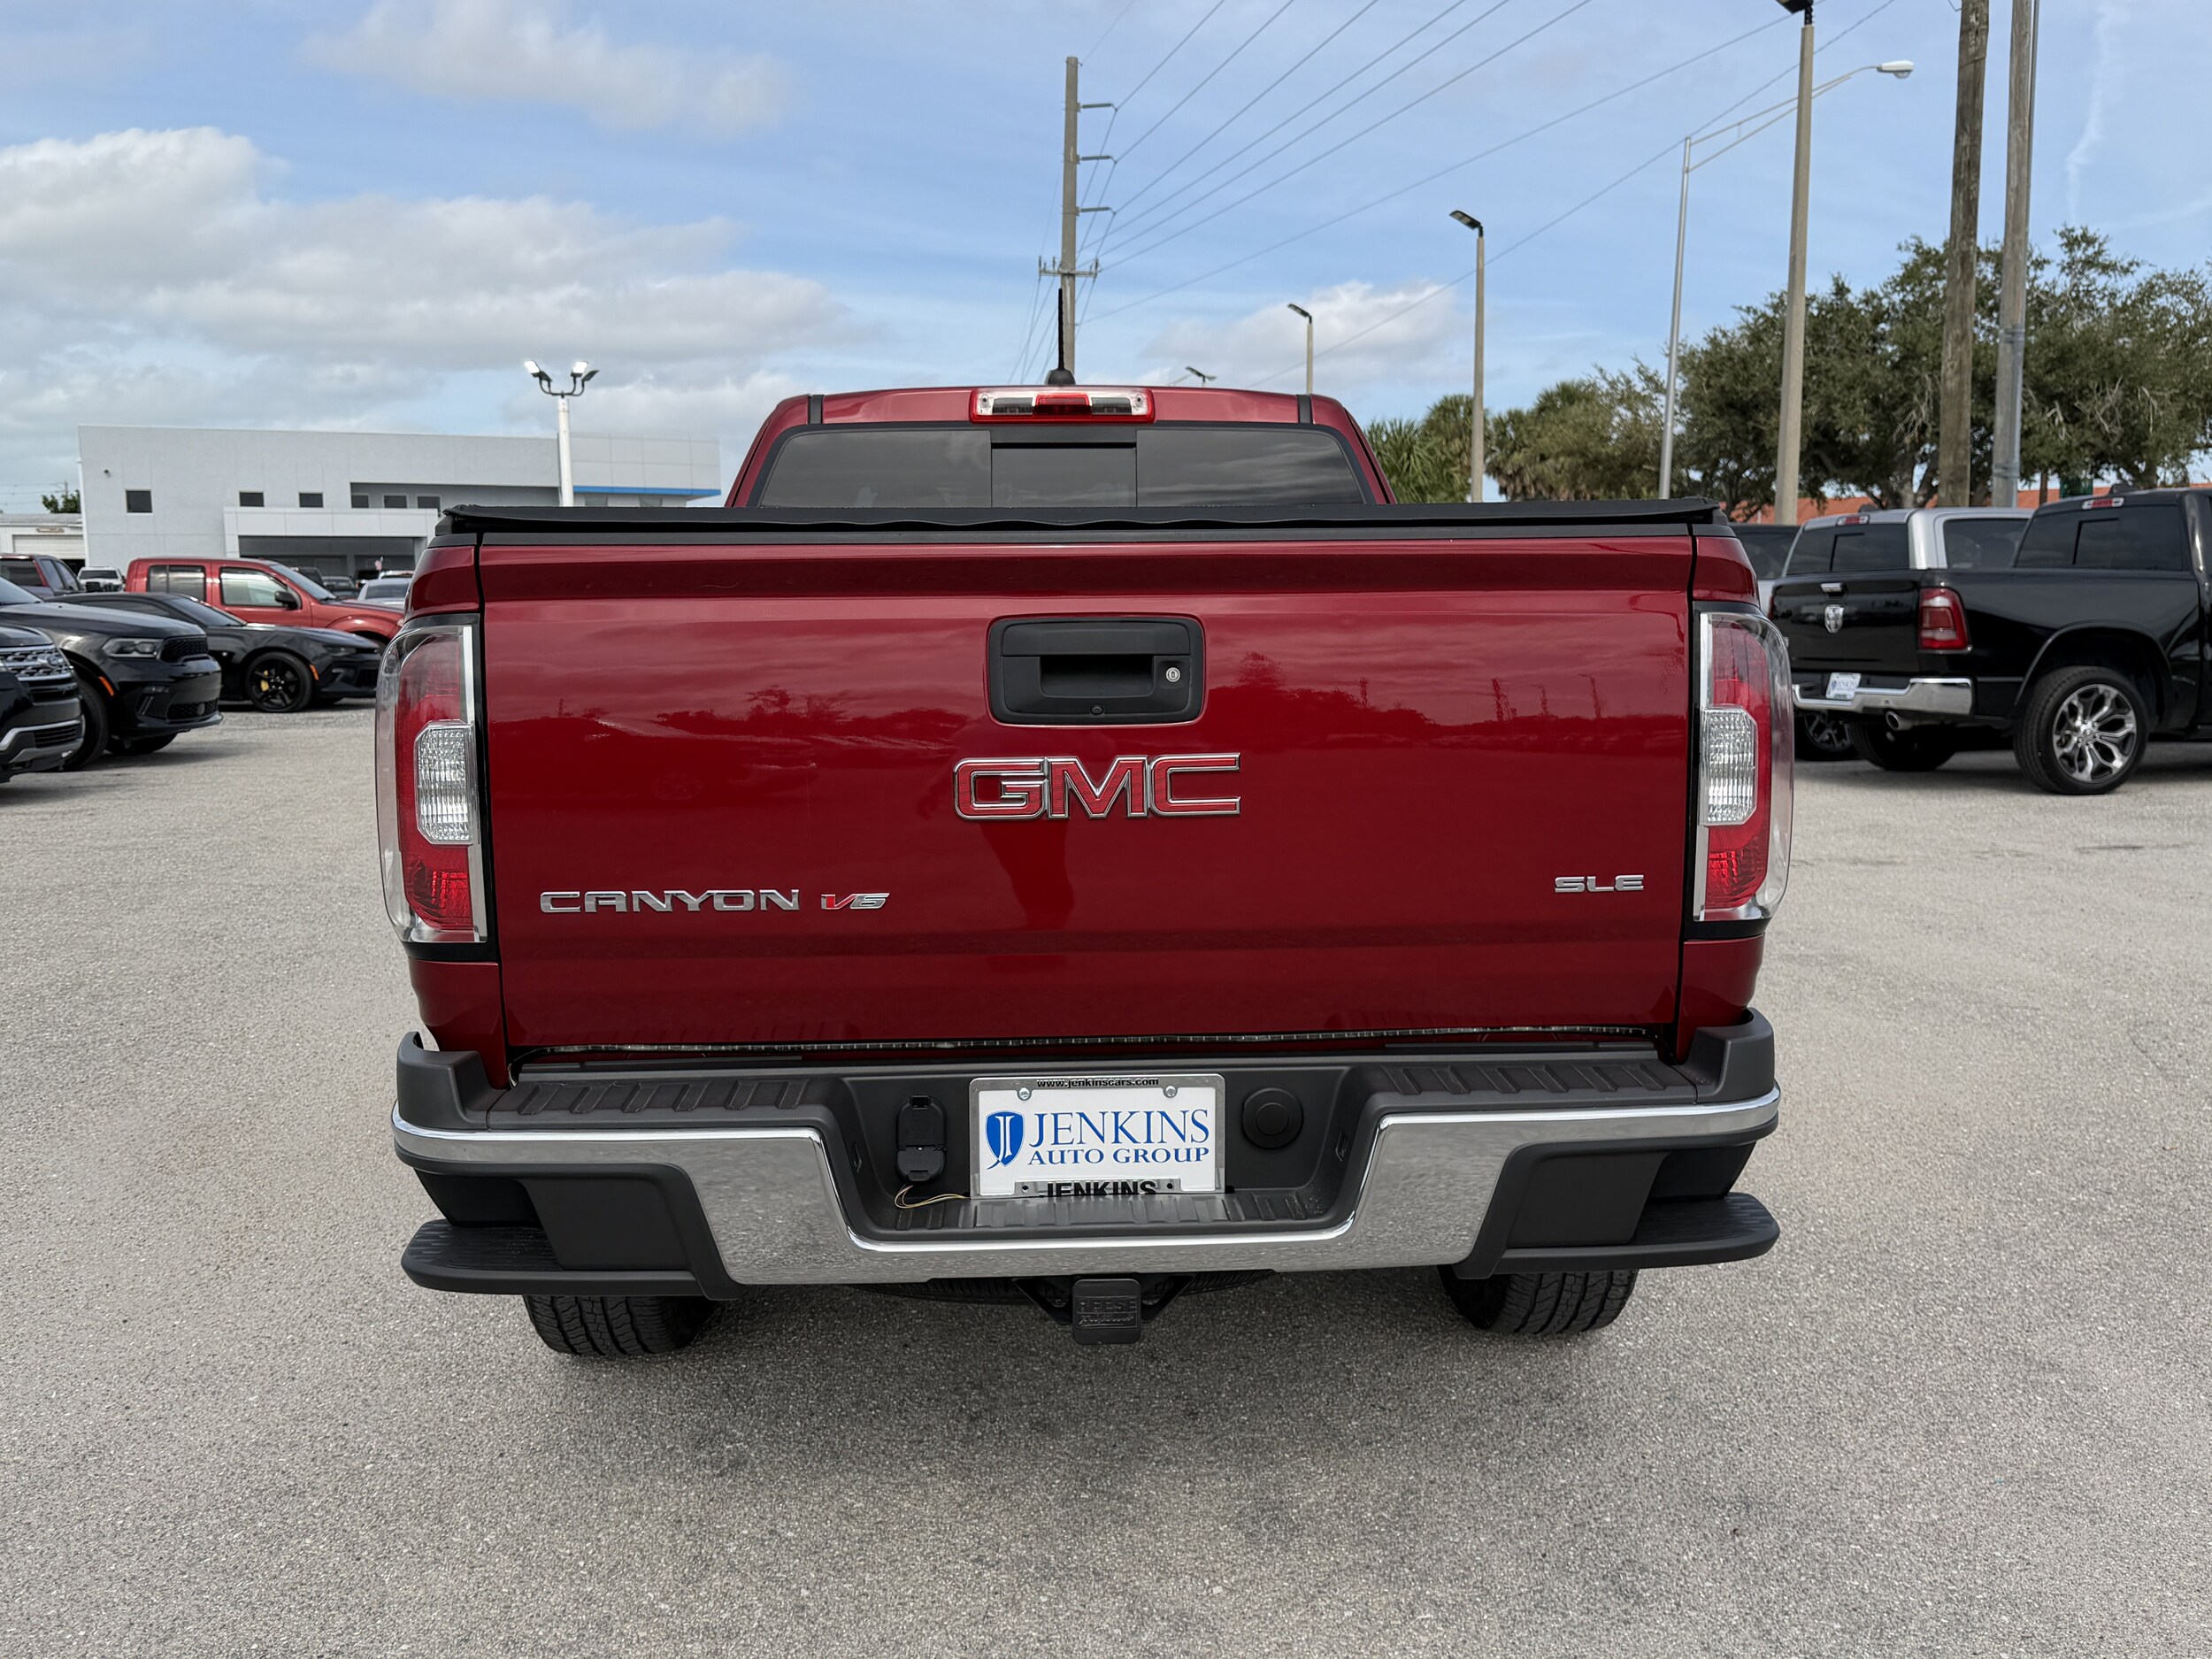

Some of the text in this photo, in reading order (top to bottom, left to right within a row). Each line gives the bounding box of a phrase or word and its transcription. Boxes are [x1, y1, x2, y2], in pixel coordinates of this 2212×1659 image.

[952, 752, 1241, 820] GMC
[1555, 874, 1645, 893] SLE
[540, 888, 891, 913] CANYON V6
[1036, 1077, 1159, 1088] www.jenkinscars.com
[1029, 1108, 1210, 1148] JENKINS
[1028, 1147, 1210, 1165] AUTO GROUP
